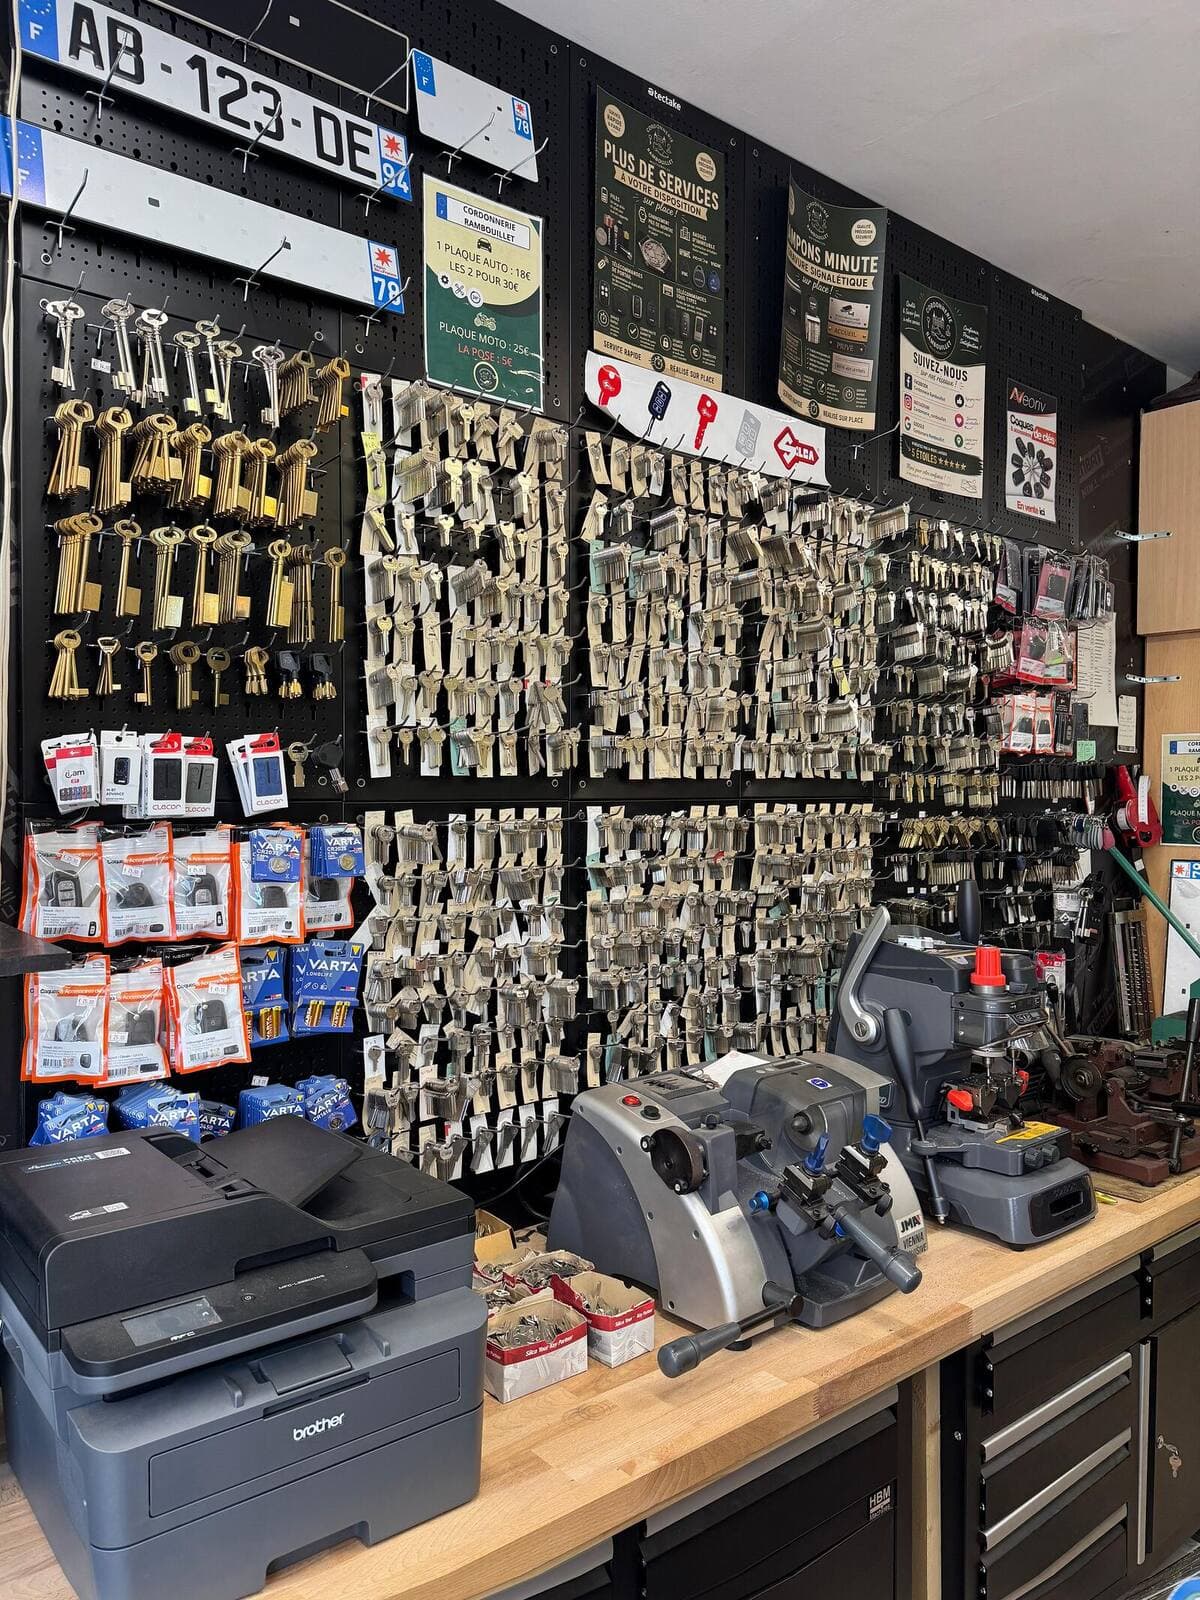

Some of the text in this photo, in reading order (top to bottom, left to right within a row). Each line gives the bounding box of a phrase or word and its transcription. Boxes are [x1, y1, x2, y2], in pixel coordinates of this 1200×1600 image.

[30, 22, 43, 40] F
[422, 76, 429, 85] F
[654, 90, 681, 111] tectake
[515, 117, 530, 134] 78
[382, 163, 410, 193] 94
[604, 139, 635, 173] PLUS
[639, 158, 655, 183] DE
[659, 169, 719, 211] SERVICES
[628, 177, 652, 194] VOTRE
[654, 187, 702, 214] DISPOSITION
[643, 197, 655, 206] sur
[655, 202, 674, 215] place
[463, 205, 516, 231] CORDONNERIE
[464, 218, 515, 242] RAMBOUILLET
[437, 241, 441, 250] 1
[444, 243, 481, 264] PLAQUE
[483, 258, 508, 273] AUTO
[515, 269, 531, 280] 18€
[824, 250, 879, 273] MINUTE
[449, 261, 519, 292] LES 2 POUR 30€
[801, 275, 811, 286] sur
[811, 279, 829, 293] place
[810, 265, 868, 287] SIGNALÉTIQUE
[374, 276, 401, 308] 78
[439, 321, 477, 340] PLAQUE
[479, 333, 507, 349] MOTO
[513, 344, 530, 356] 25€
[458, 344, 470, 354] LA
[472, 348, 495, 361] POSE
[501, 356, 513, 367] 5€
[603, 340, 642, 361] SERVICE RAPIDE
[690, 370, 700, 380] SUR
[700, 372, 715, 385] PLACE
[913, 352, 968, 382] SUIVEZ-NOUS
[848, 416, 864, 424] PLACE
[1010, 414, 1034, 431] Coques
[1016, 501, 1024, 510] En
[1024, 503, 1039, 515] vente
[1170, 809, 1196, 817] PLAQUE
[257, 840, 299, 854] VARTA
[325, 838, 361, 846] VARTA
[309, 958, 358, 973] VARTA
[149, 1108, 197, 1123] VARTA
[262, 1104, 303, 1117] VARTA
[309, 1093, 347, 1117] VARTA
[51, 1113, 101, 1141] VARTA
[900, 1214, 921, 1233] JMA
[903, 1235, 925, 1249] VIENNA
[293, 1412, 345, 1441] brother
[869, 1485, 890, 1508] HBM
